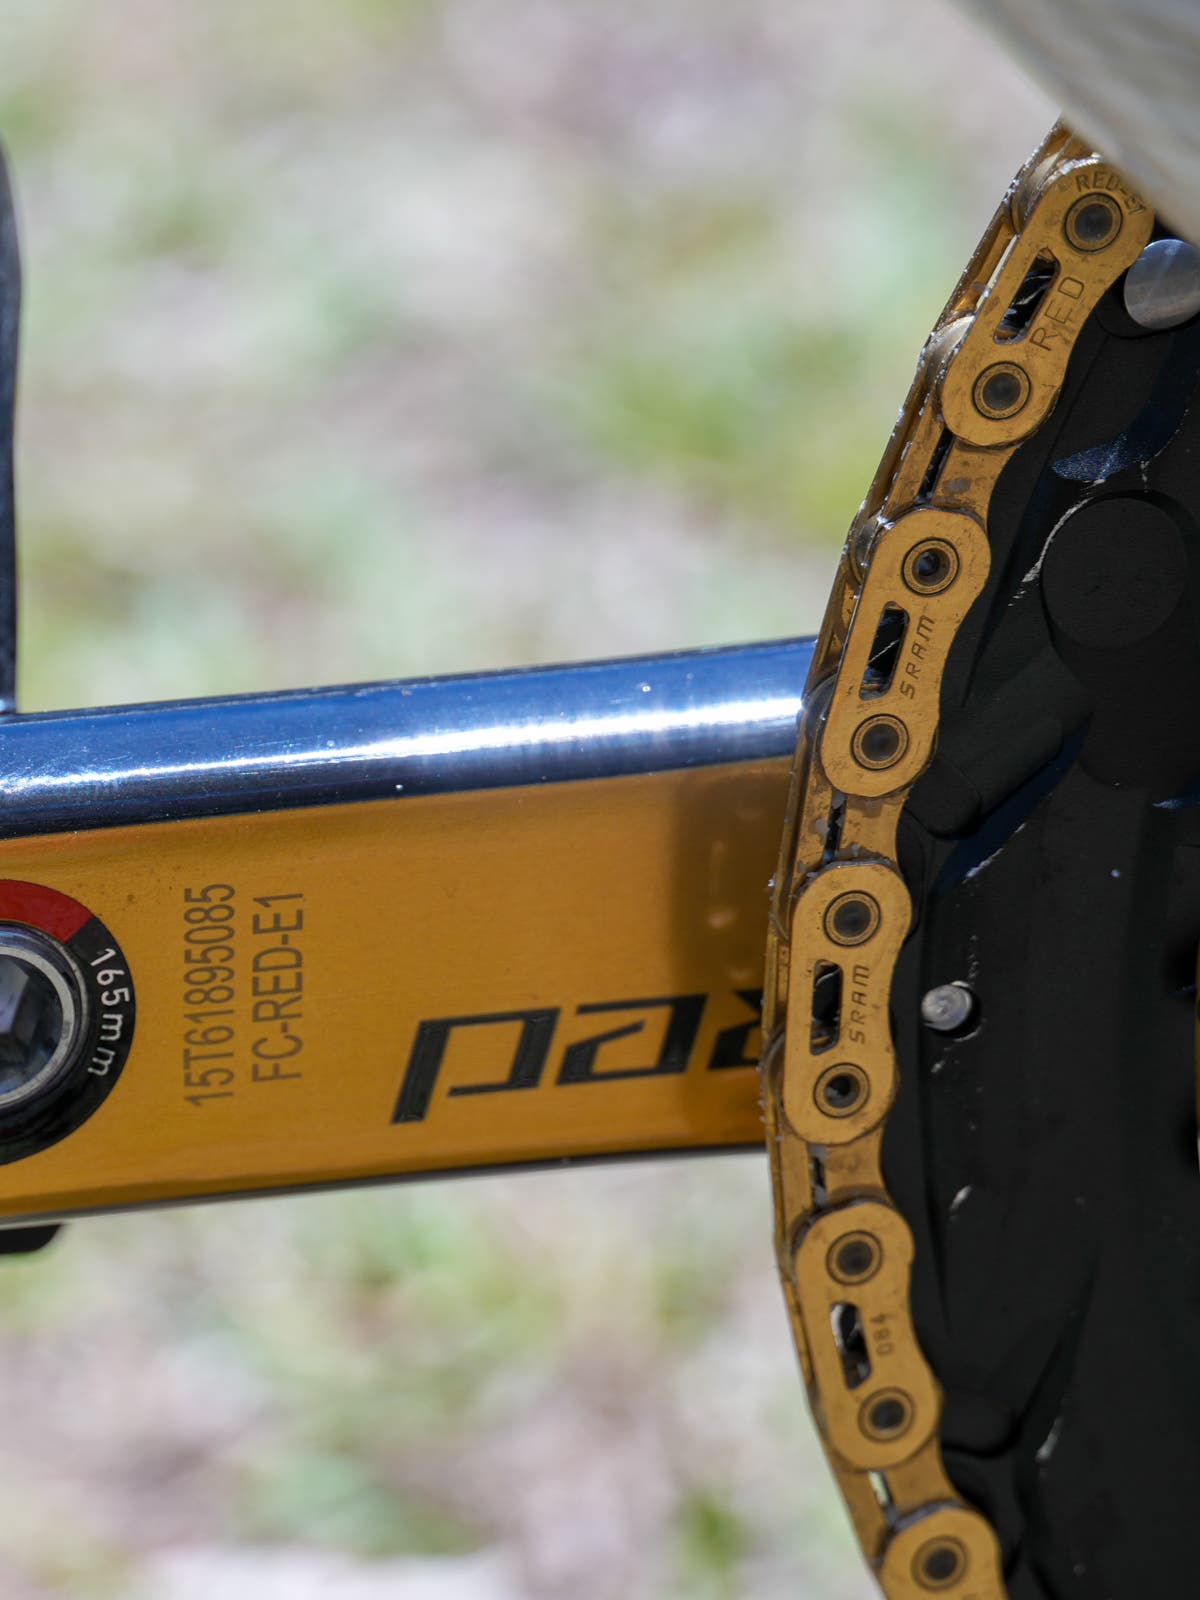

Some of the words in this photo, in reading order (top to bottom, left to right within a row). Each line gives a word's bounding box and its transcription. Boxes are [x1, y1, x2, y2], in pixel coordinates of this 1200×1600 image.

[1030, 275, 1086, 352] RED
[900, 615, 936, 700] SRAM
[89, 947, 131, 1078] 165mm
[183, 882, 236, 1108] 15T61895085
[252, 891, 304, 1085] FC-RED-E1
[849, 964, 871, 1044] SRAM
